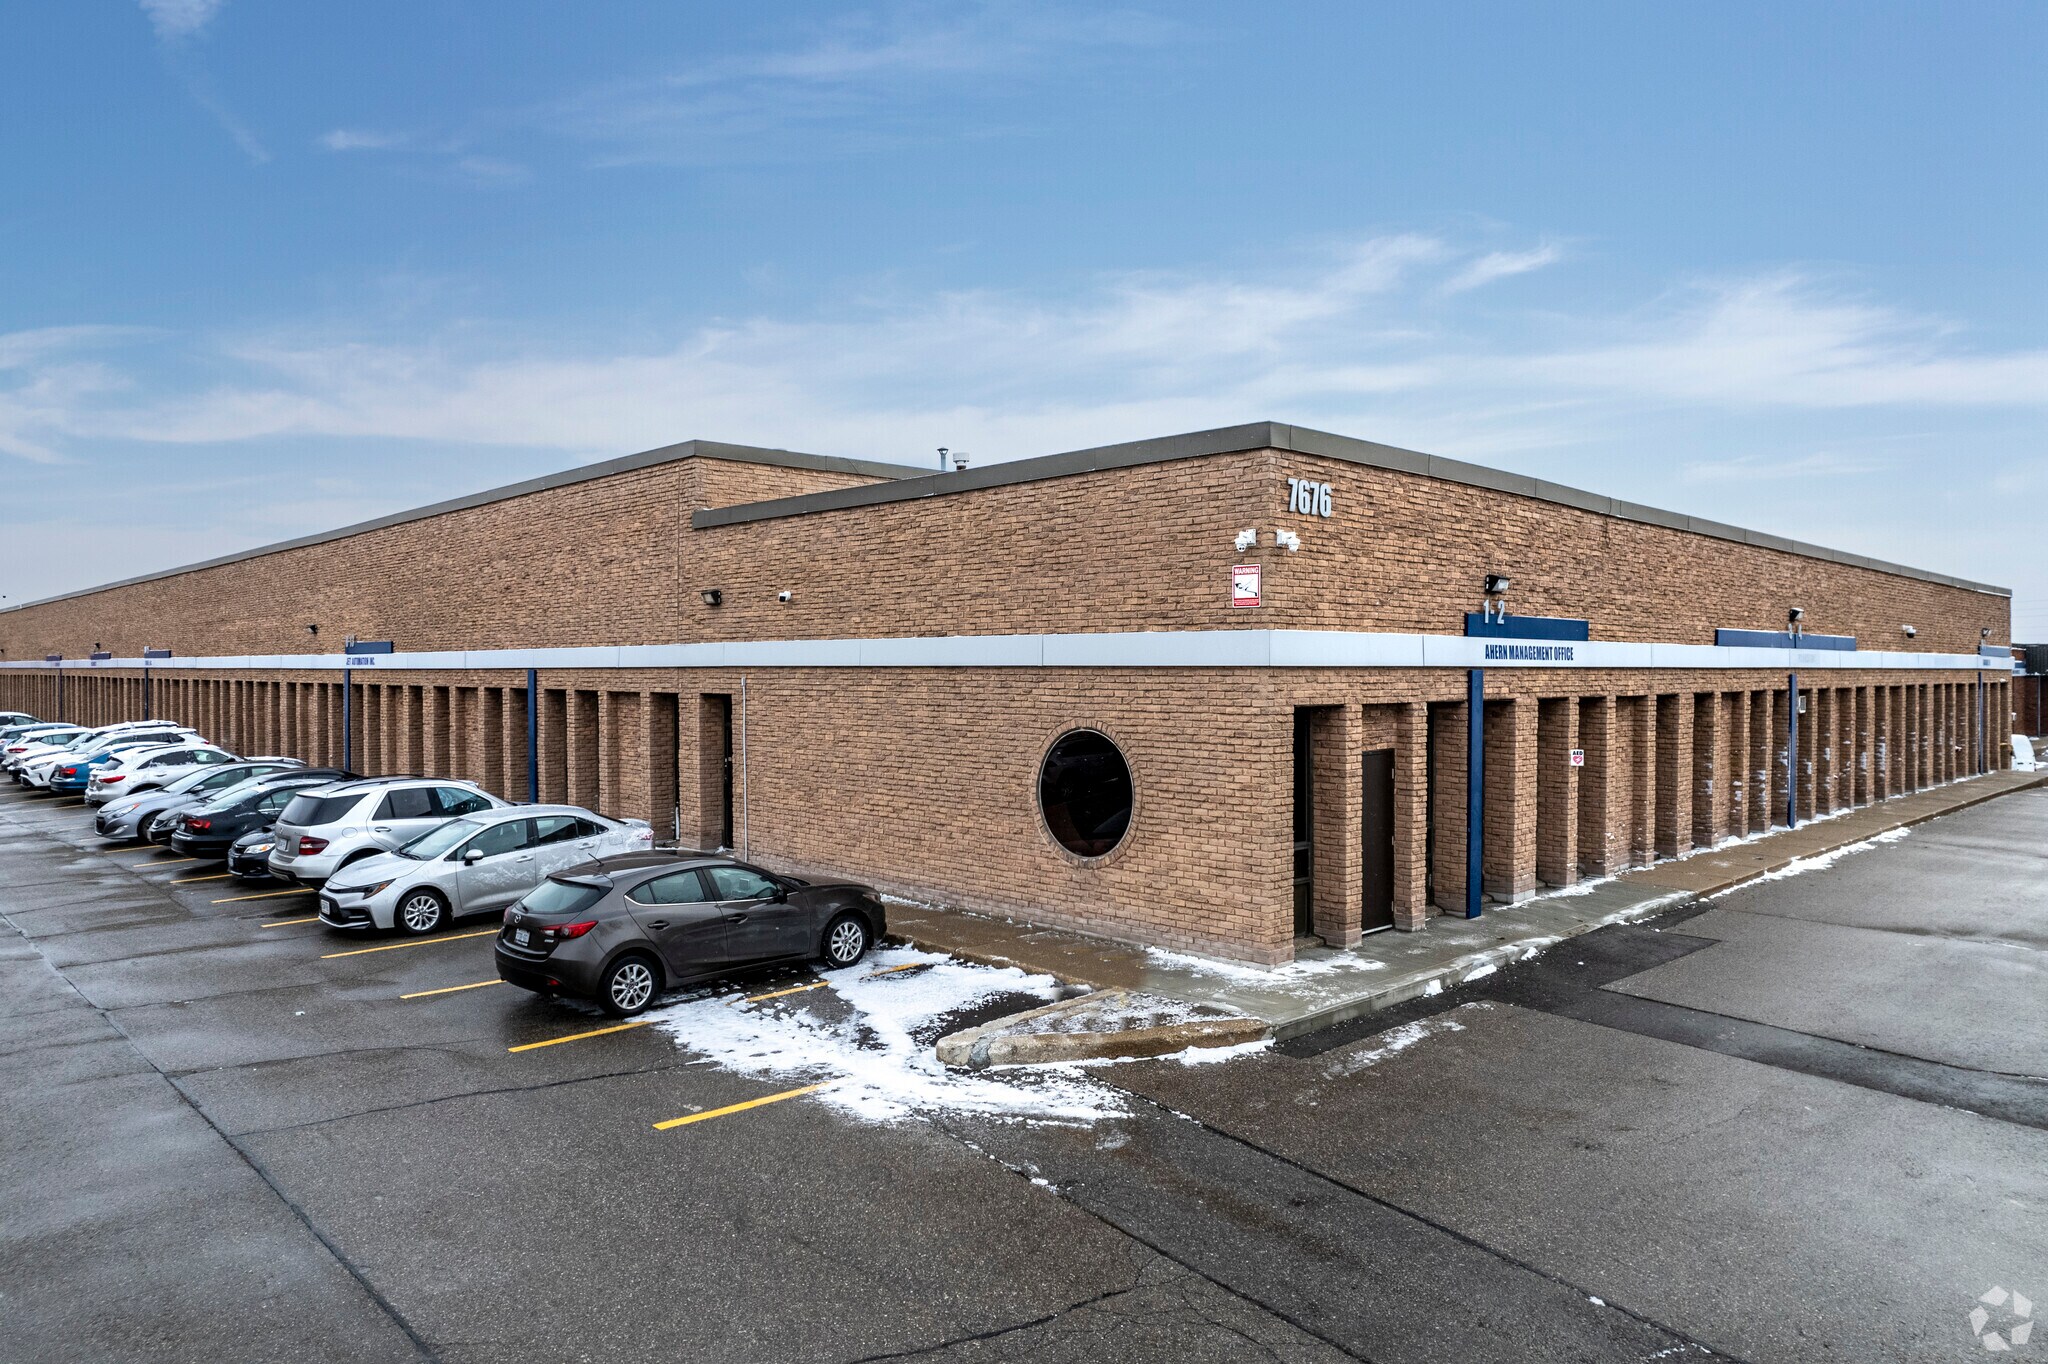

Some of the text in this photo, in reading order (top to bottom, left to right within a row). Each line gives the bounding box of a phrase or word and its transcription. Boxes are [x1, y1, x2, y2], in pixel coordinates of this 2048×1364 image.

[1287, 477, 1332, 518] 7676
[1485, 644, 1574, 661] AHERN MANAGEMENT OFFICE
